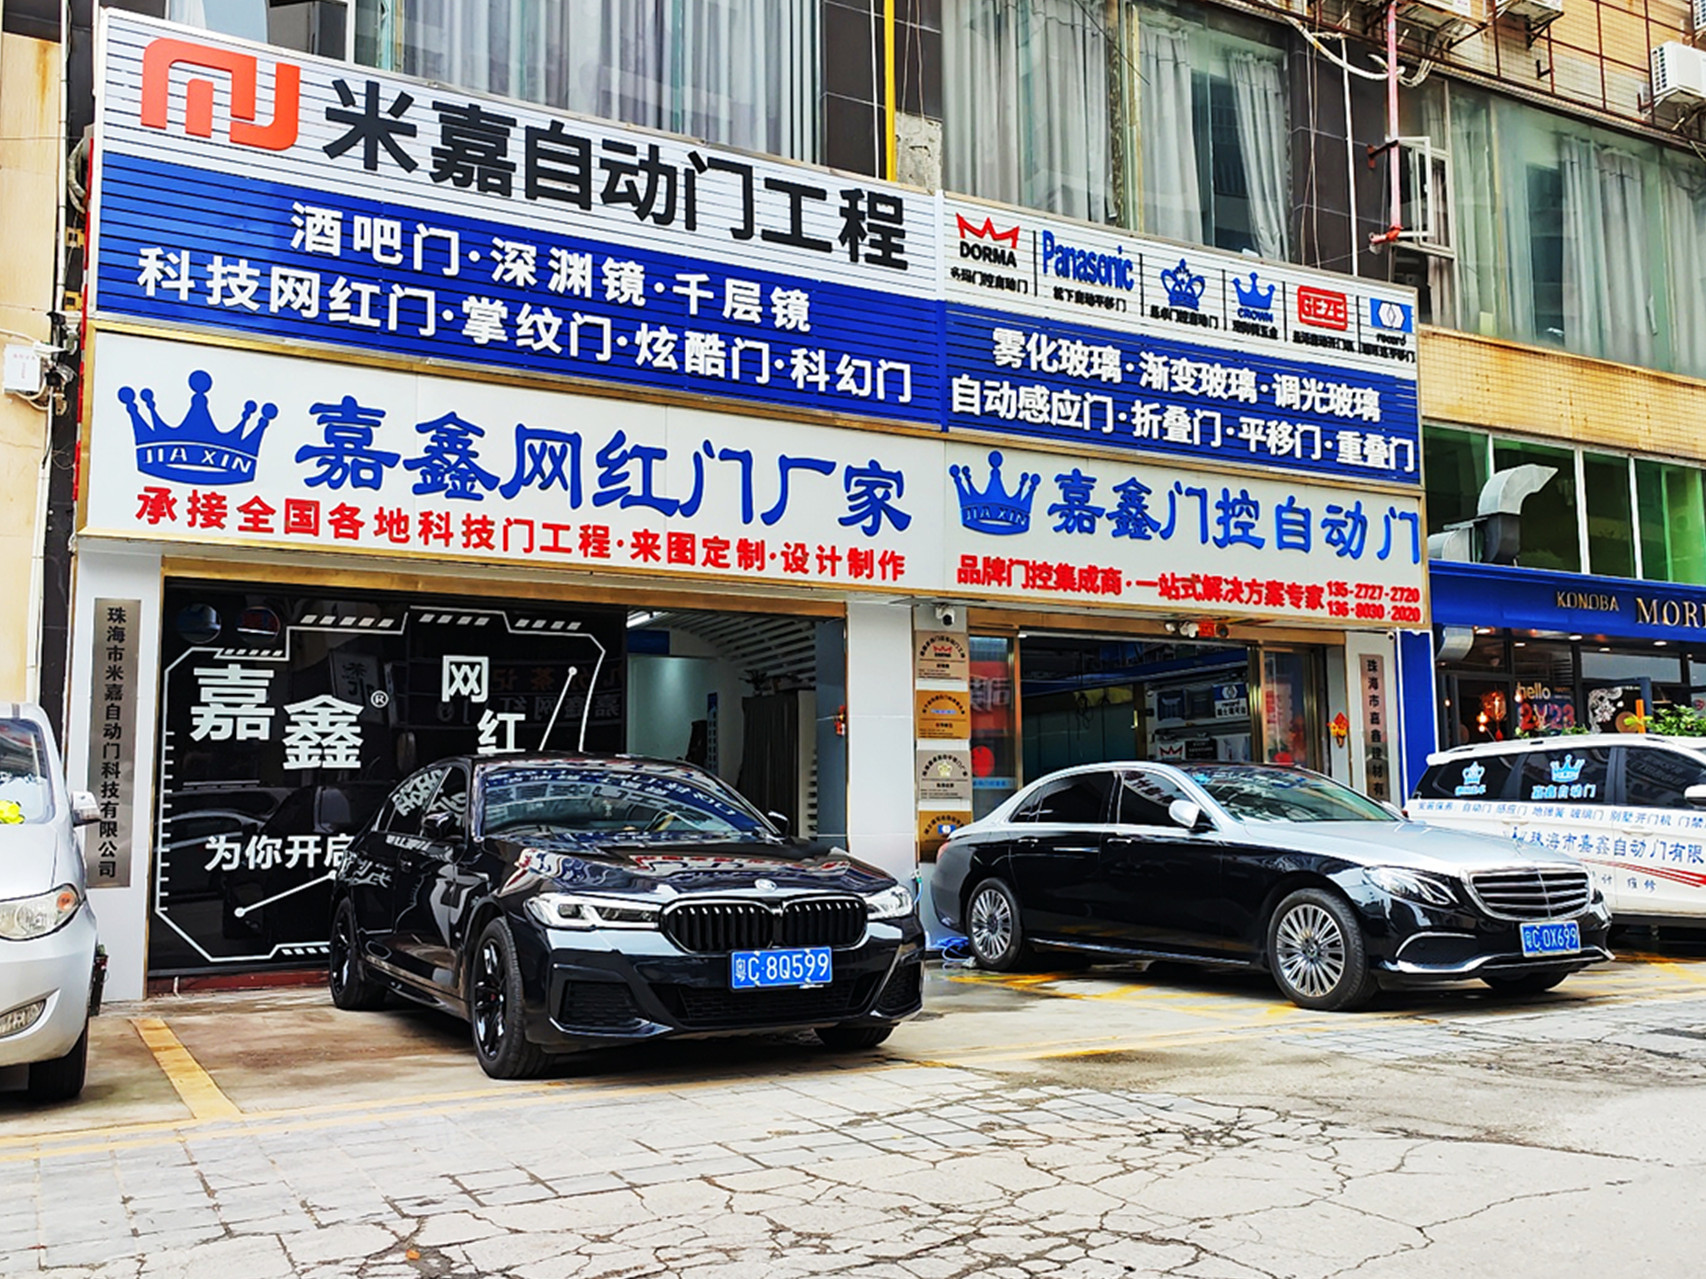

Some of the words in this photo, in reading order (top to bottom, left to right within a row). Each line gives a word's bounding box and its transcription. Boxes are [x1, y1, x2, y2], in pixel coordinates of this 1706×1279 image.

[323, 80, 908, 271] 米嘉自动门工程
[290, 201, 811, 332] 酒吧门·深渊镜·千层镜
[960, 241, 1017, 268] DORMA
[1042, 230, 1134, 291] Panasonic
[137, 247, 912, 403] 科技网红门·掌纹门·炫酷门·科幻门
[1237, 307, 1273, 323] CROWN
[1302, 296, 1346, 321] GEZE
[1376, 333, 1406, 346] record
[992, 327, 1381, 423] 雾化玻璃·渐变玻璃·调光玻璃
[952, 374, 1415, 472] 自动感应门·折叠门·平移门·重叠门
[145, 448, 188, 464] JIA
[202, 450, 253, 473] XIN
[295, 396, 911, 536] 嘉鑫网红门厂家
[135, 487, 906, 581] 承接全国各地科技门工程·来图定制·设计制作
[966, 506, 990, 520] JIA
[997, 507, 1027, 525] XIN
[1048, 468, 1420, 564] 嘉鑫门控自动门
[957, 555, 1325, 610] 品牌门控集成商·一站式解决方案专家
[1556, 591, 1620, 611] KONOBA
[190, 664, 365, 770] 嘉鑫
[1517, 682, 1551, 700] hello
[97, 606, 127, 879] 珠海市米嘉自动门科技有限公司
[1462, 803, 1491, 813] 自动门
[1678, 815, 1706, 829] 门禁
